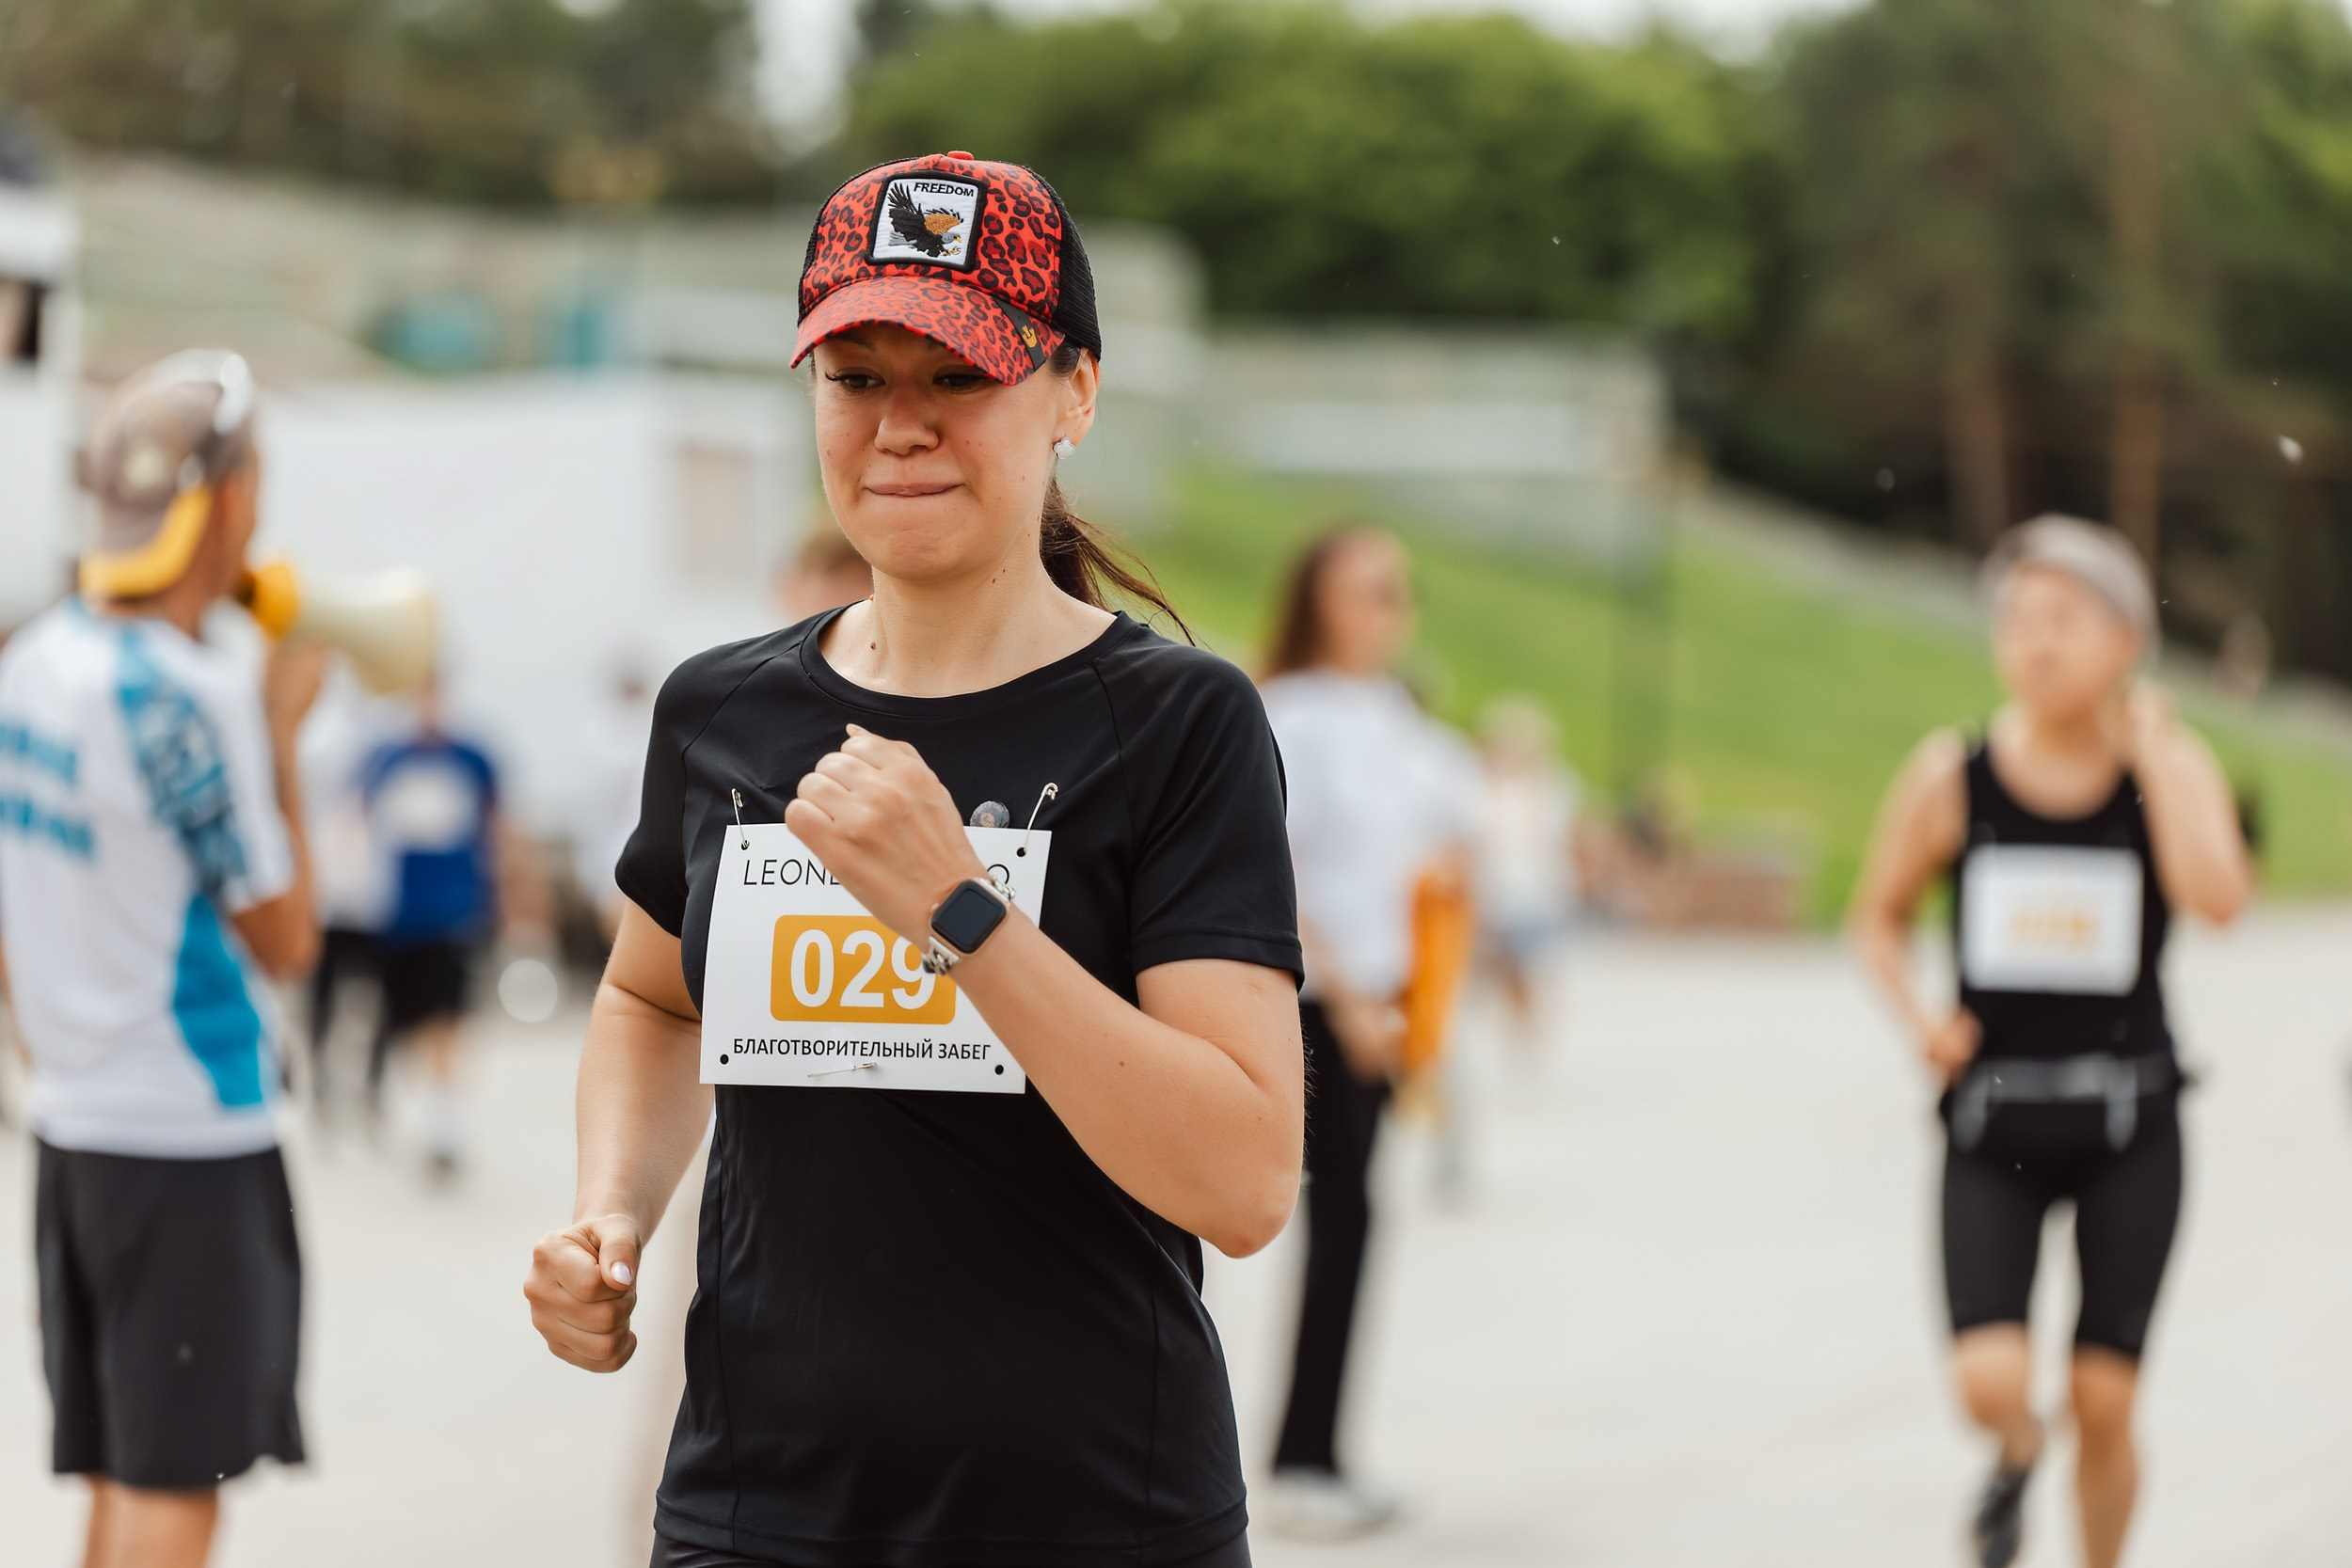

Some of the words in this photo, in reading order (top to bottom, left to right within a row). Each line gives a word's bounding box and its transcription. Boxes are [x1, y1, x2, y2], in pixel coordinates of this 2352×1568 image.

[914, 182, 974, 197] FREEDOM
[790, 928, 936, 1010] 029
[733, 1038, 933, 1059] БЛАГОТВОРИТЕЛЬНЫЙ
[938, 1043, 991, 1060] ЗАБЕГ
